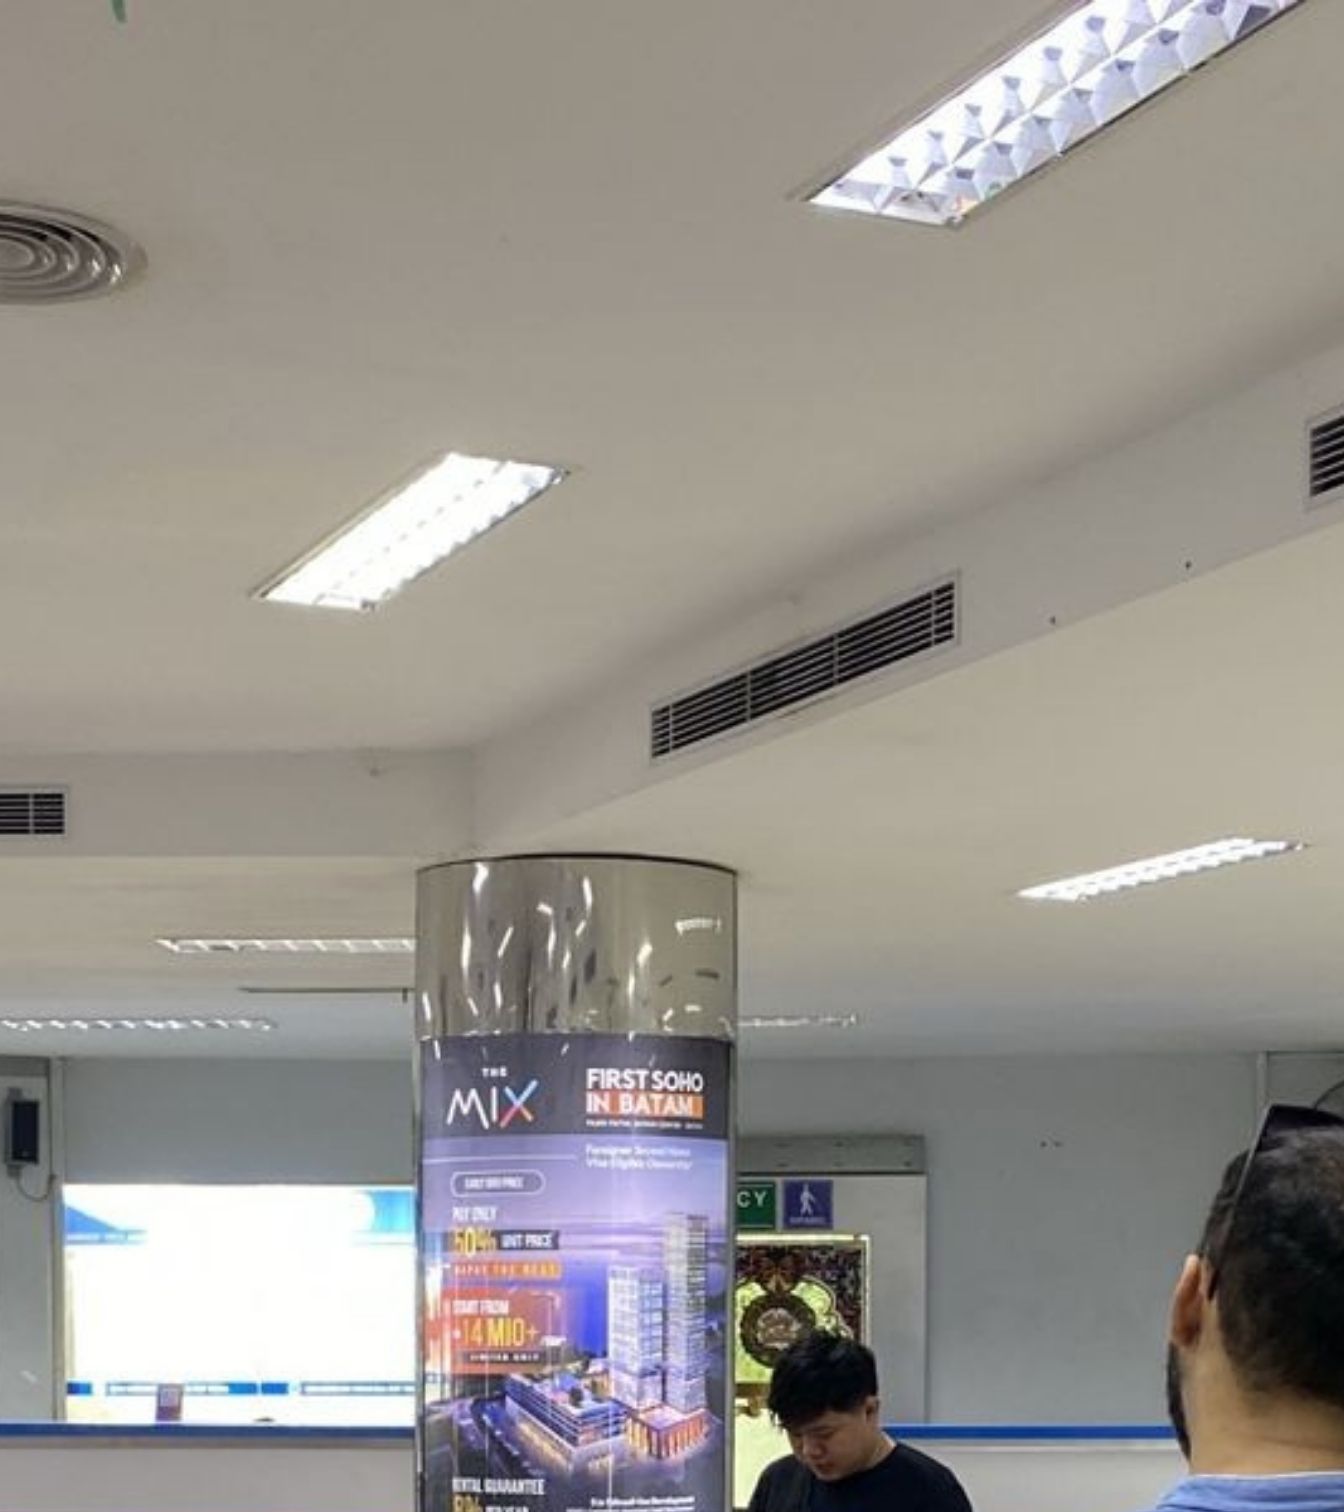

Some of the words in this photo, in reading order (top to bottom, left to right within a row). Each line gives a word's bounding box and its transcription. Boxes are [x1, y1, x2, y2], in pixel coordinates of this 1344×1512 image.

[586, 1069, 649, 1089] FIRST
[651, 1070, 704, 1092] SOHO
[447, 1080, 538, 1129] MIX
[586, 1091, 610, 1113] IN
[525, 1233, 553, 1248] PRICE
